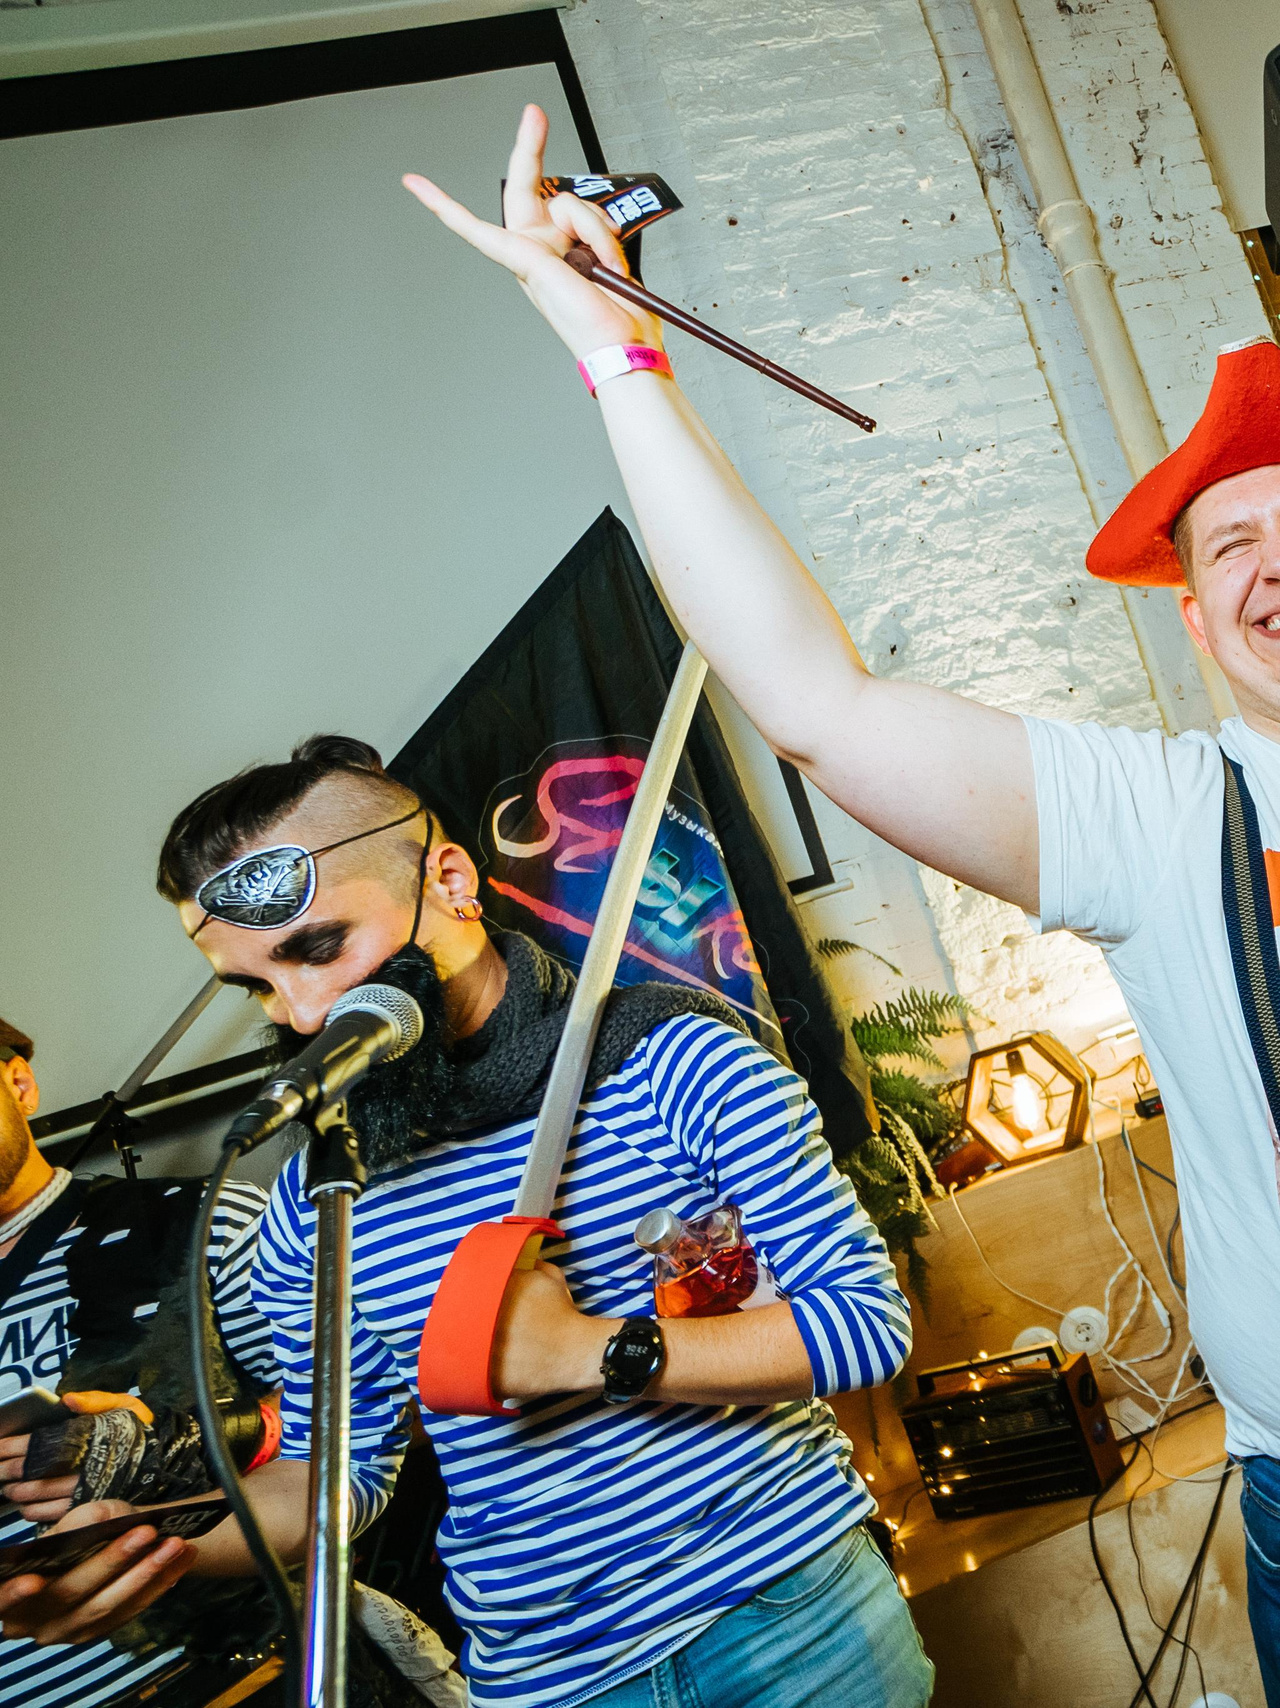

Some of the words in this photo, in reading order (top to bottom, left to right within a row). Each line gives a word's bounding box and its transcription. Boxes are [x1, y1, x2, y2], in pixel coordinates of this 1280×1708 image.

[615, 193, 643, 222] PUB
[631, 185, 663, 214] CITY
[161, 1508, 220, 1527] CITY
